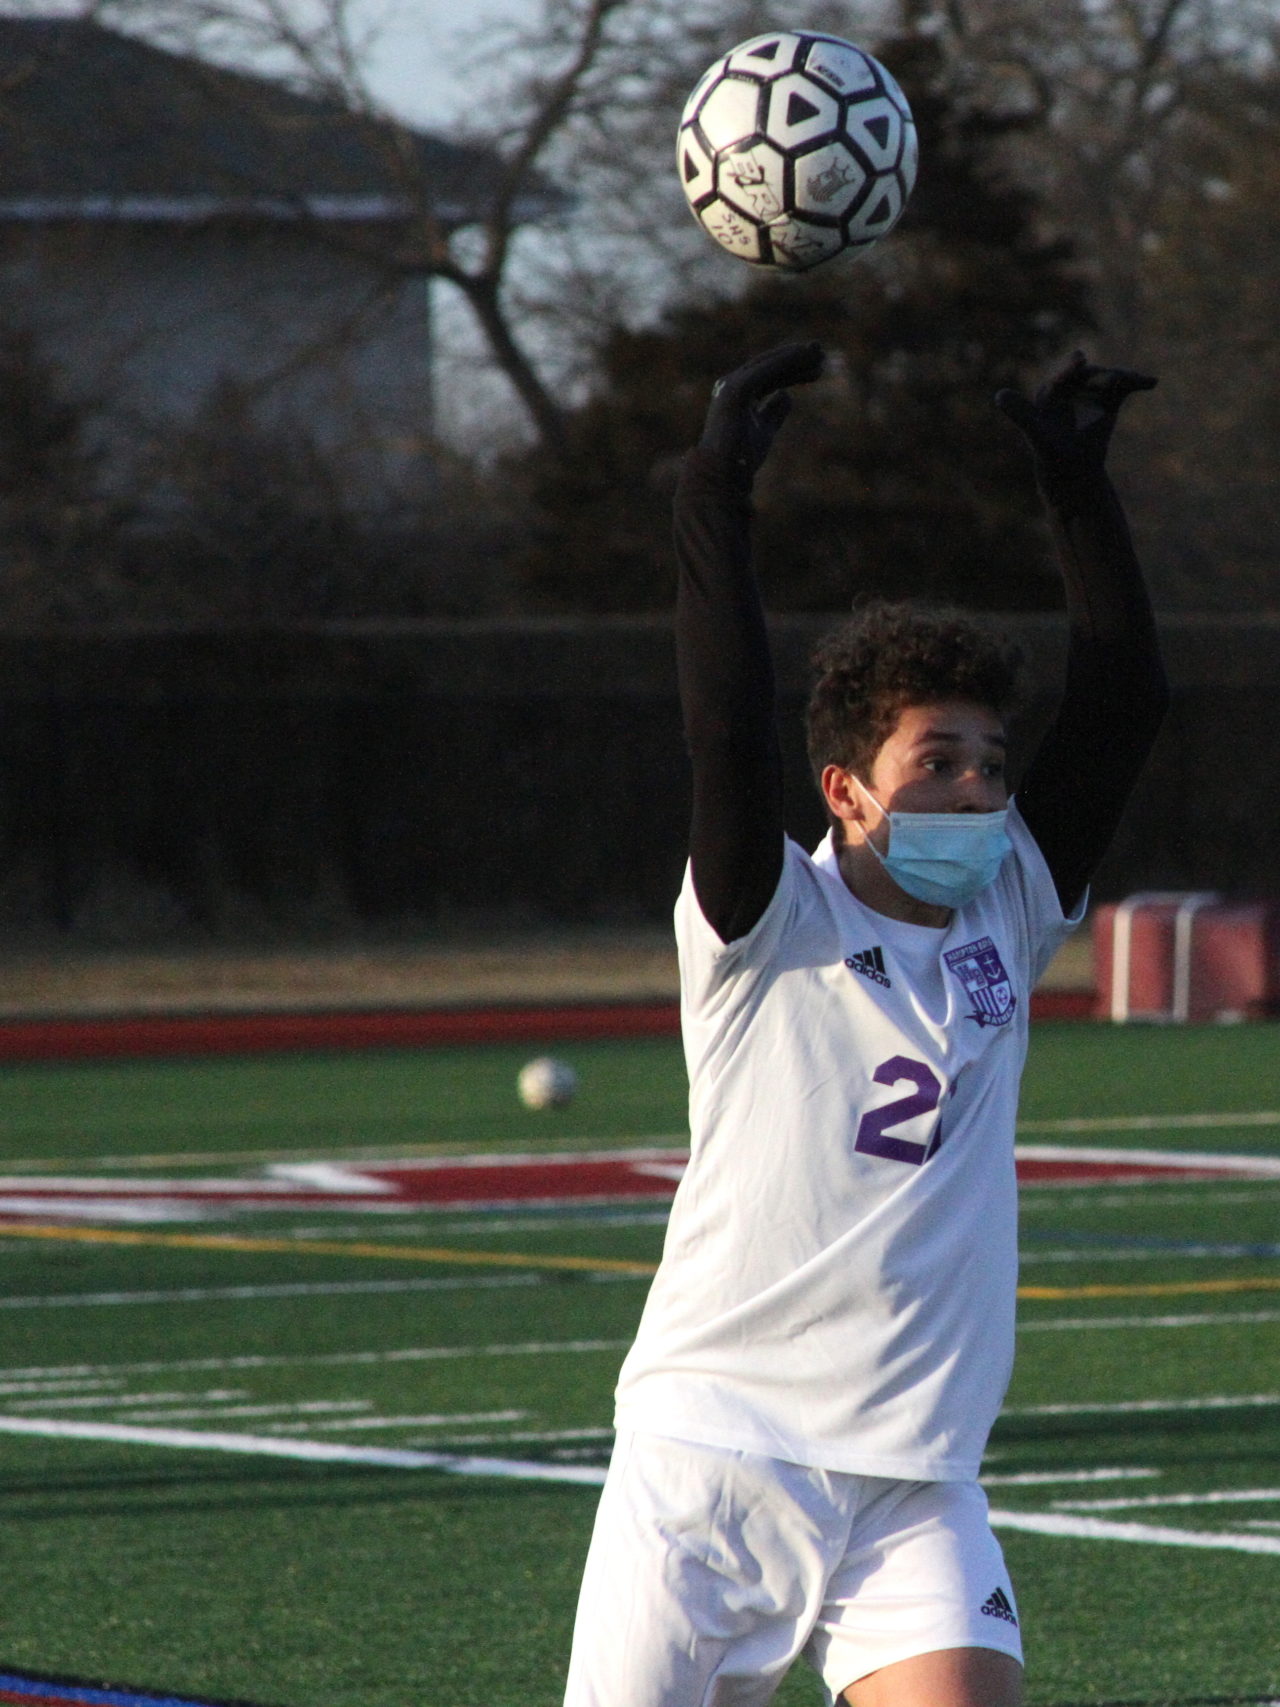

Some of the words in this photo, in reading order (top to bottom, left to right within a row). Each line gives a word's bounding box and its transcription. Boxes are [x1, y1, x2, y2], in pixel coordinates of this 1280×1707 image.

[844, 957, 891, 989] adidas
[854, 1055, 942, 1166] 2
[980, 1605, 1018, 1628] adida
